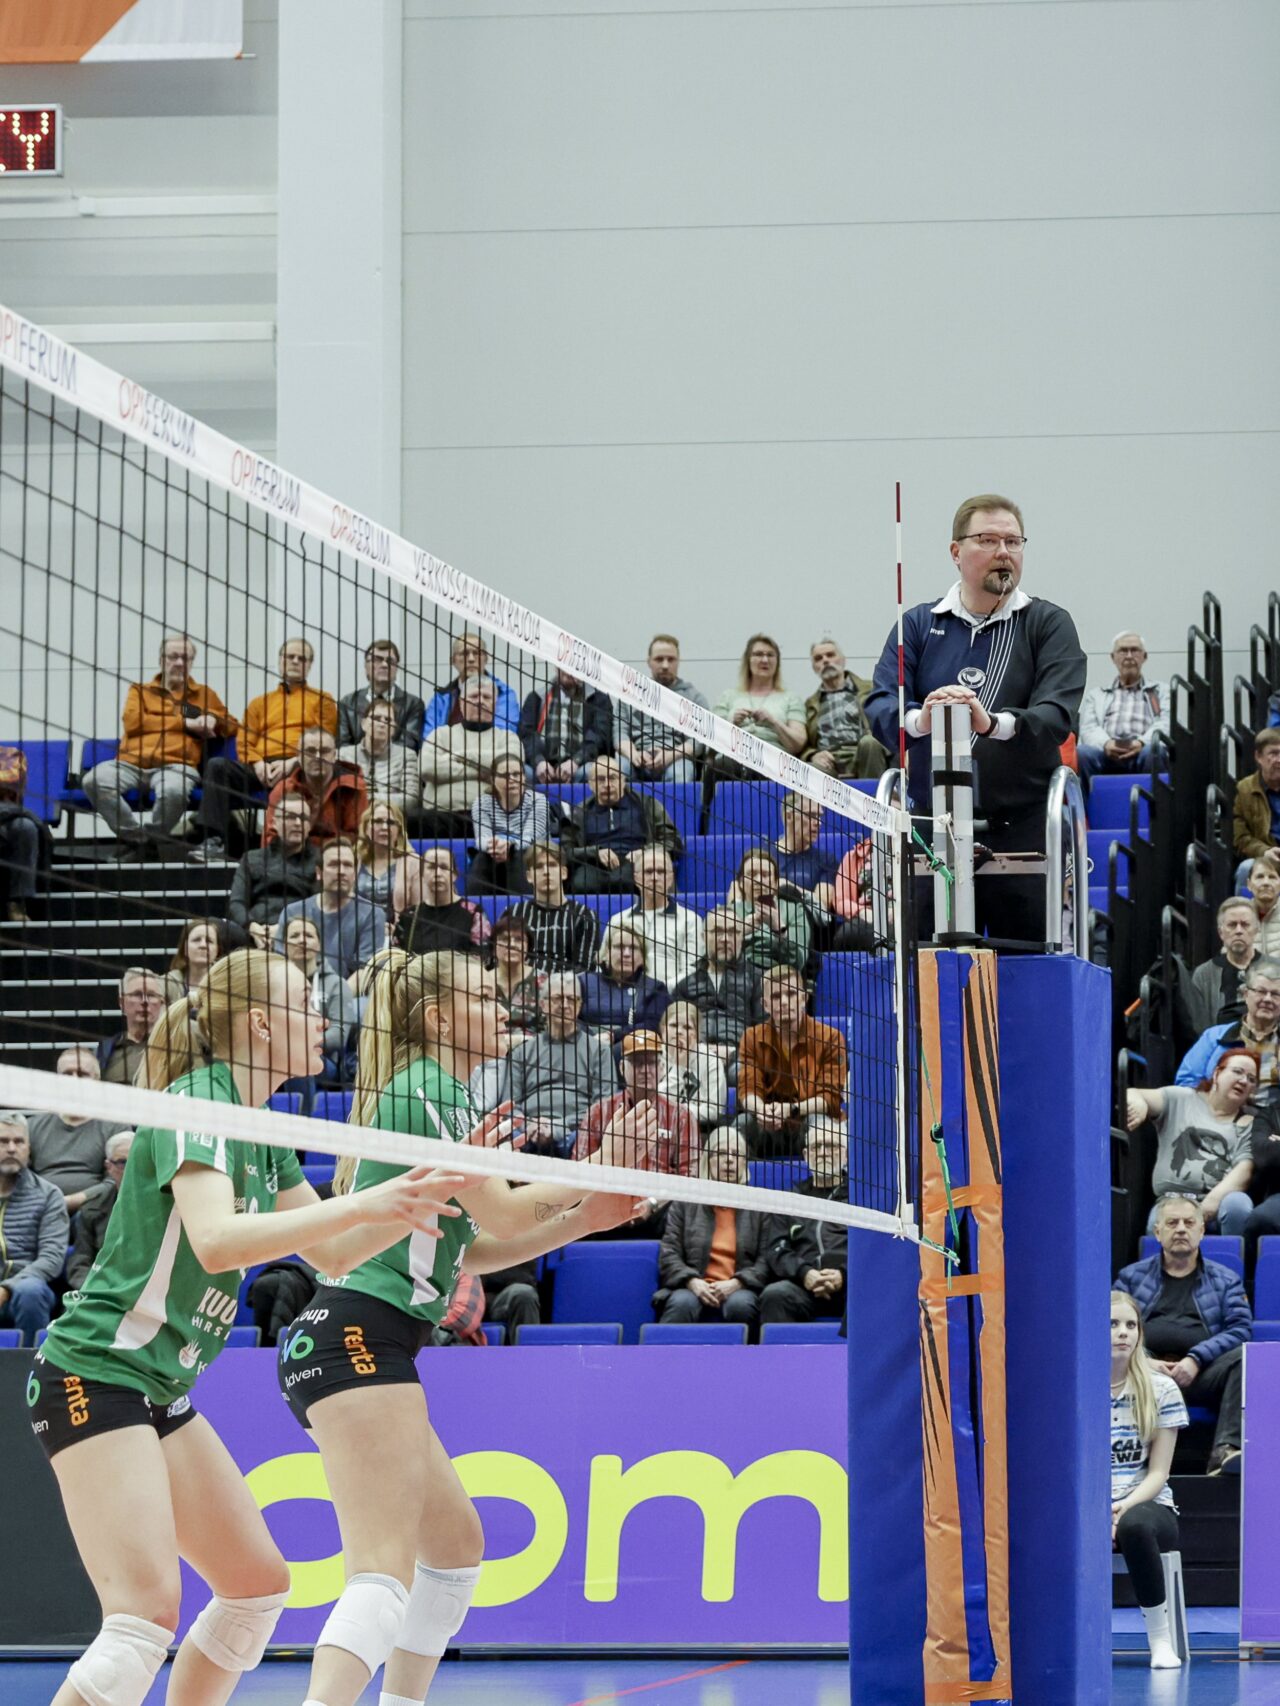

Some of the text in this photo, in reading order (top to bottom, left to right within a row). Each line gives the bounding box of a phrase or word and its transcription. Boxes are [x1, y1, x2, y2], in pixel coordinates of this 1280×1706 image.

[0, 313, 77, 394] PIFERUM
[343, 1325, 377, 1375] renta
[63, 1371, 91, 1427] enta
